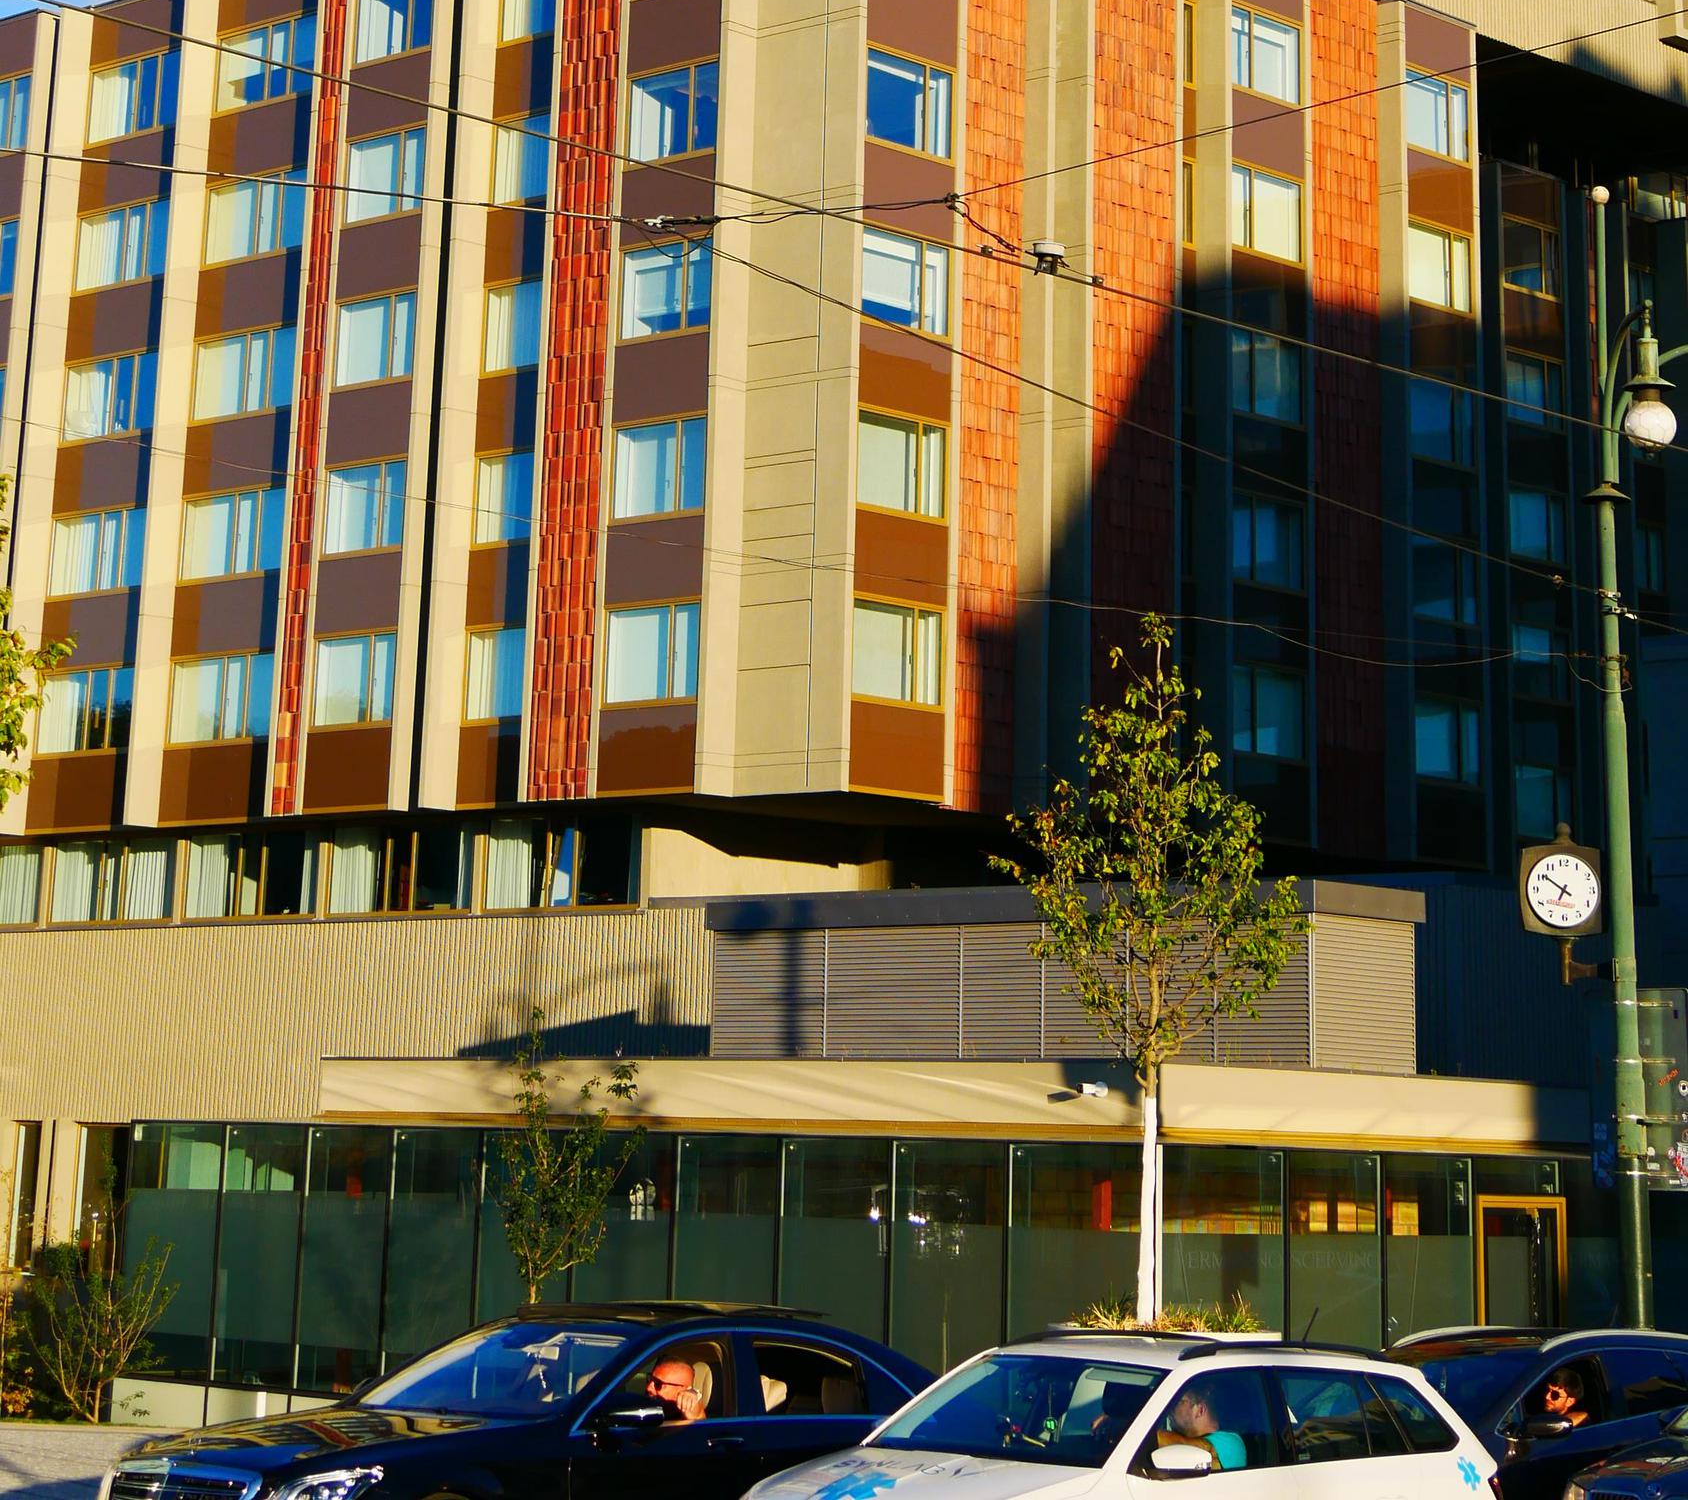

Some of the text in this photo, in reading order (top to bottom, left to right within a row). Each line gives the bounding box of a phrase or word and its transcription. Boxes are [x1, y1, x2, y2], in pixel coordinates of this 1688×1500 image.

[1546, 863, 1555, 871] 11
[1559, 859, 1569, 867] 12
[1533, 886, 1539, 894] 9
[1589, 886, 1595, 894] 3
[1562, 913, 1568, 922] 6
[1576, 910, 1582, 918] 5
[1187, 1251, 1282, 1269] ERMNO
